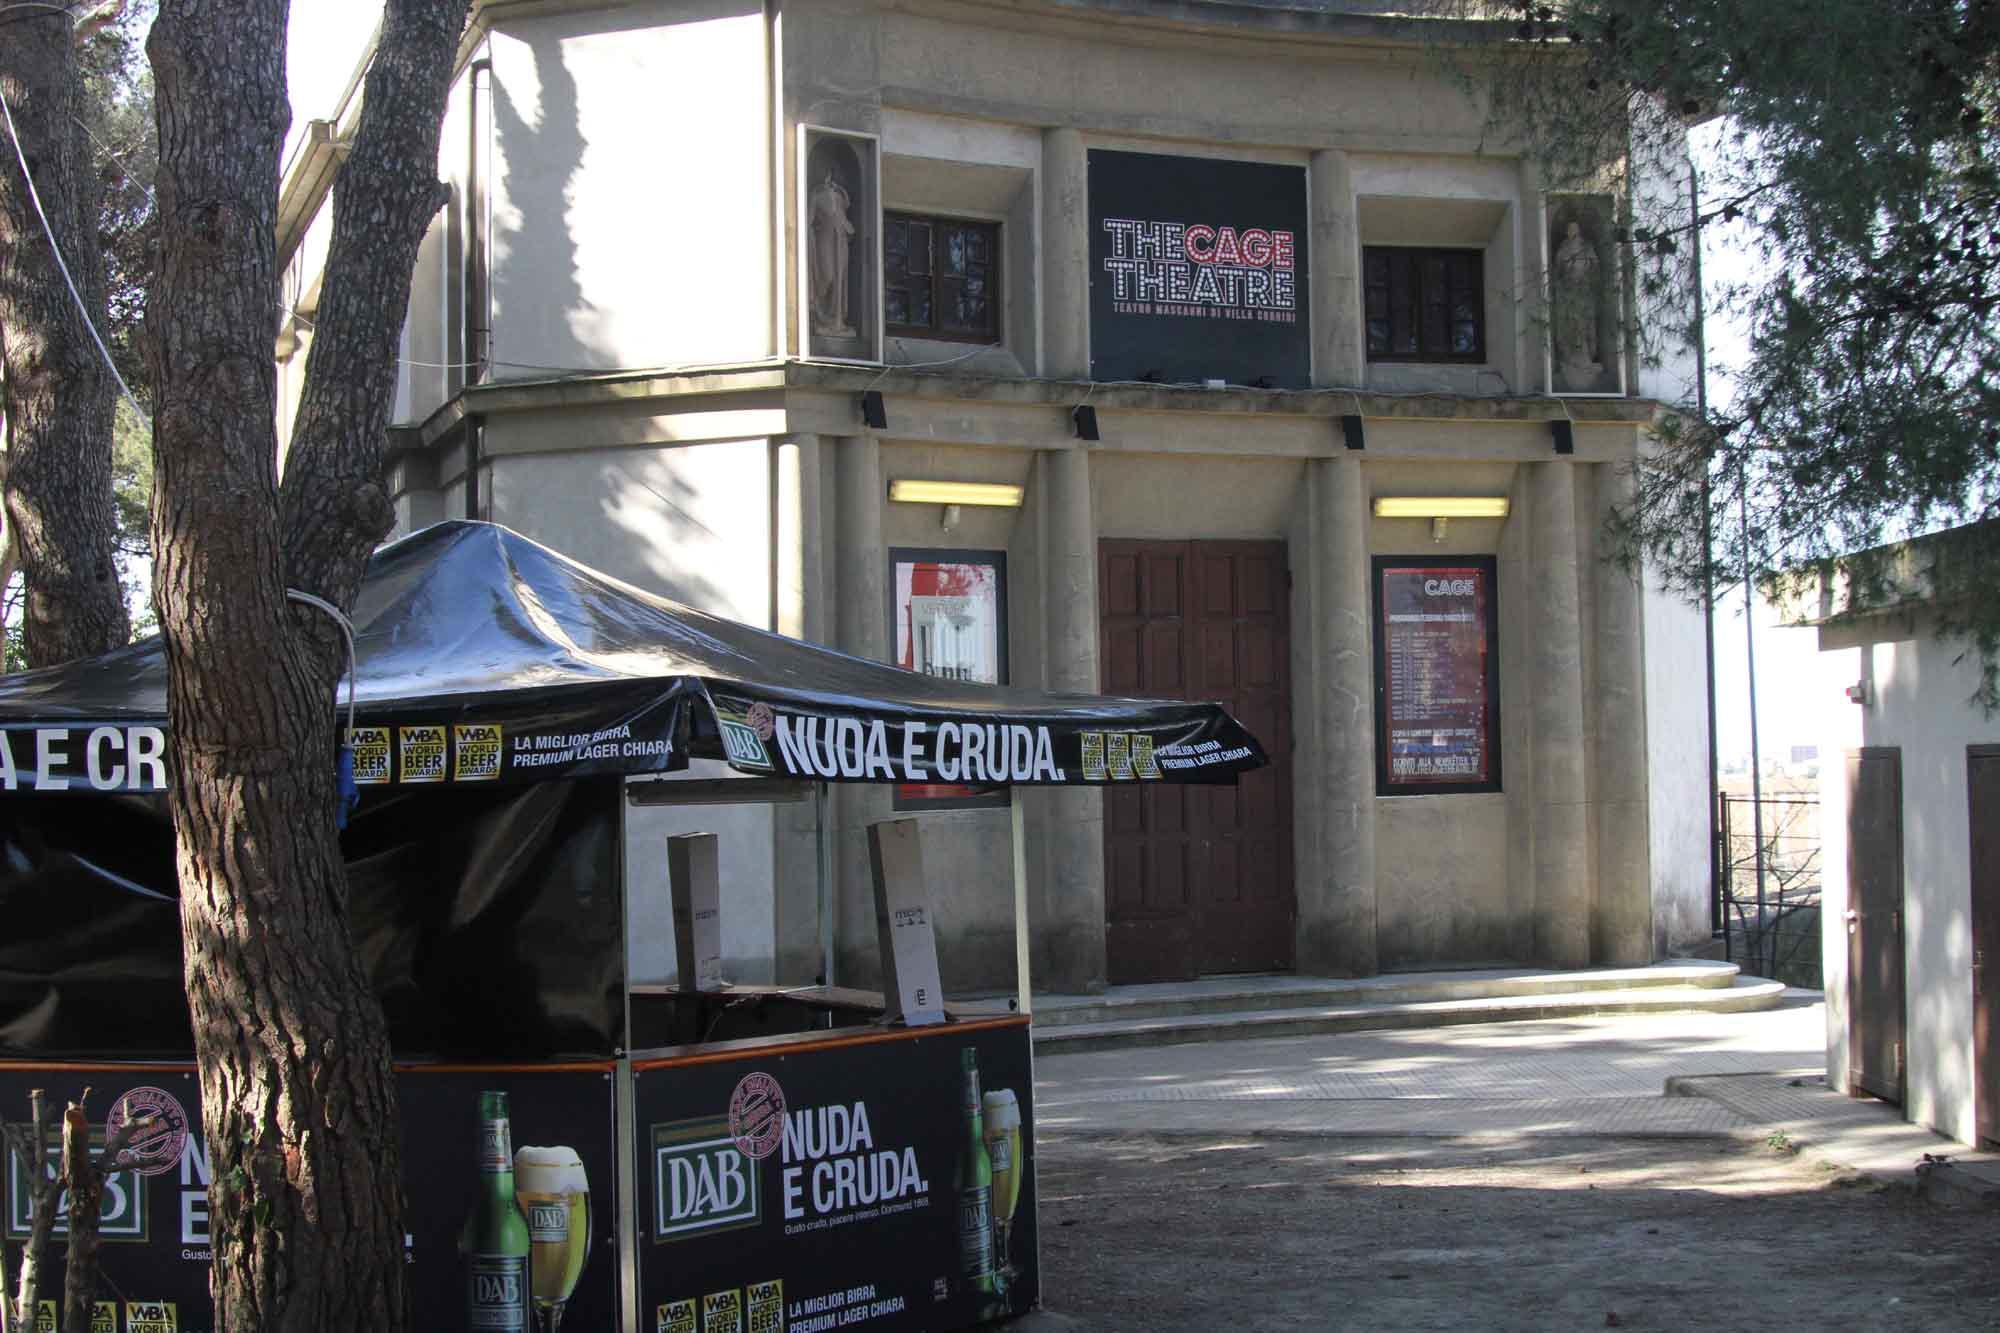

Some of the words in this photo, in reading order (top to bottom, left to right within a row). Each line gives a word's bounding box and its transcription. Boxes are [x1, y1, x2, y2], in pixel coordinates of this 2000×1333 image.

[1104, 218, 1185, 263] THE
[1184, 224, 1294, 269] CAGE
[1104, 258, 1295, 310] THEATRE
[1113, 302, 1151, 314] TEATRO
[1424, 578, 1475, 596] CAGE
[403, 728, 442, 742] WBA
[458, 727, 497, 741] WBA
[514, 737, 532, 750] LA
[536, 733, 591, 749] MIGLIOR
[592, 725, 631, 743] BIRRA
[723, 725, 762, 760] DAB
[404, 745, 444, 755] WORLD
[459, 744, 499, 753] WORLD
[513, 750, 573, 767] PREMIUM
[576, 743, 619, 760] LAGER
[623, 740, 674, 757] CHIARA
[776, 715, 896, 779] NUDA
[903, 721, 928, 780] E
[936, 721, 1067, 782] CRUDA.
[1194, 740, 1222, 753] BIRRA
[35, 728, 69, 790] E
[405, 755, 442, 768] BEER
[459, 754, 497, 767] BEER
[1161, 759, 1196, 769] PREMIUM
[1194, 753, 1222, 766] LAGER
[1220, 746, 1252, 761] CHIARA
[404, 768, 443, 776] AWARDS
[458, 766, 497, 775] AWARDS
[782, 1101, 873, 1163] NUDA
[668, 1150, 746, 1221] DAB
[783, 1166, 804, 1219] E
[812, 1146, 929, 1213] CRUDA.
[182, 1191, 210, 1243] E
[535, 1209, 562, 1228] DAB
[479, 1275, 519, 1302] DAB
[750, 1284, 780, 1301] WBA
[706, 1293, 738, 1312] WBA
[789, 1302, 802, 1318] LA
[804, 1292, 845, 1314] MIGLIOR
[847, 1284, 877, 1304] BIRRA
[130, 1306, 172, 1320] WBA
[660, 1303, 693, 1322] WBA
[707, 1312, 738, 1325] WORLD
[751, 1311, 780, 1331] BEER
[789, 1313, 836, 1333] PREMIUM
[838, 1306, 869, 1326] LAGER
[870, 1296, 905, 1317] CHIARA
